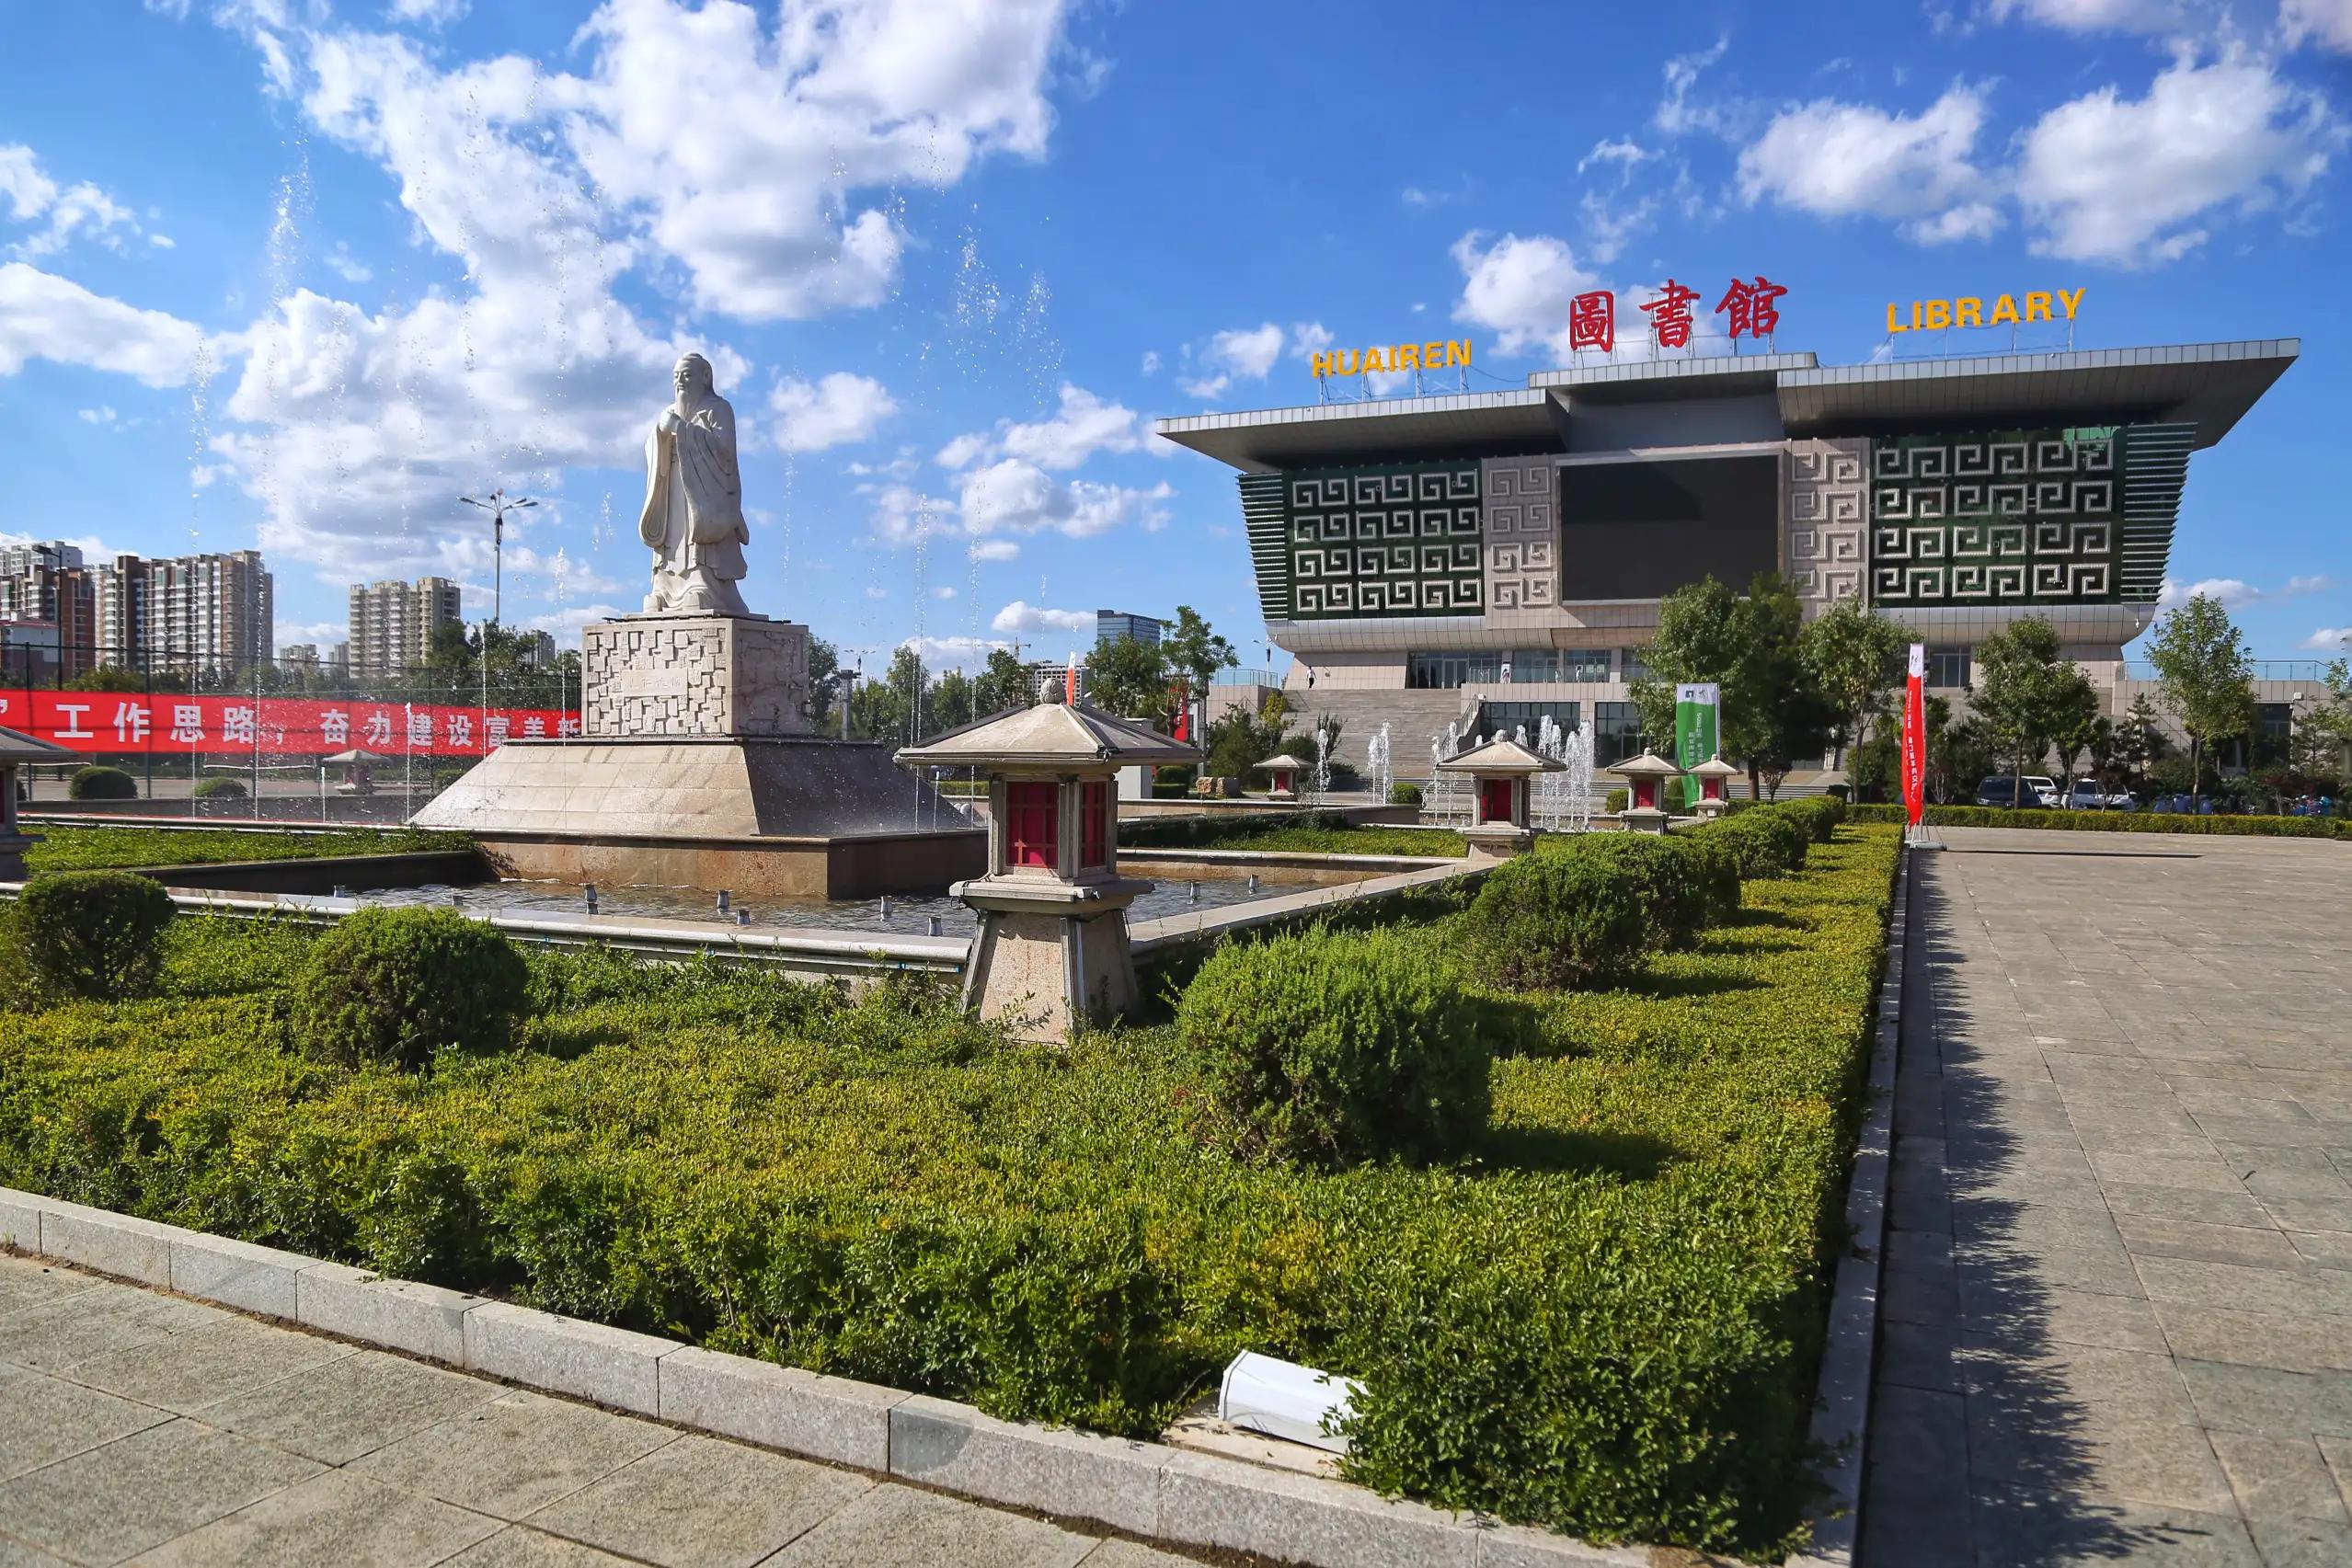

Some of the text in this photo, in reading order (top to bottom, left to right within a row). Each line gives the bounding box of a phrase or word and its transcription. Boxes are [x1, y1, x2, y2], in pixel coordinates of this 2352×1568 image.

[1569, 277, 1788, 352] 圖書館
[1887, 287, 2086, 333] LIBRARY
[1312, 338, 1472, 378] HUAIREN
